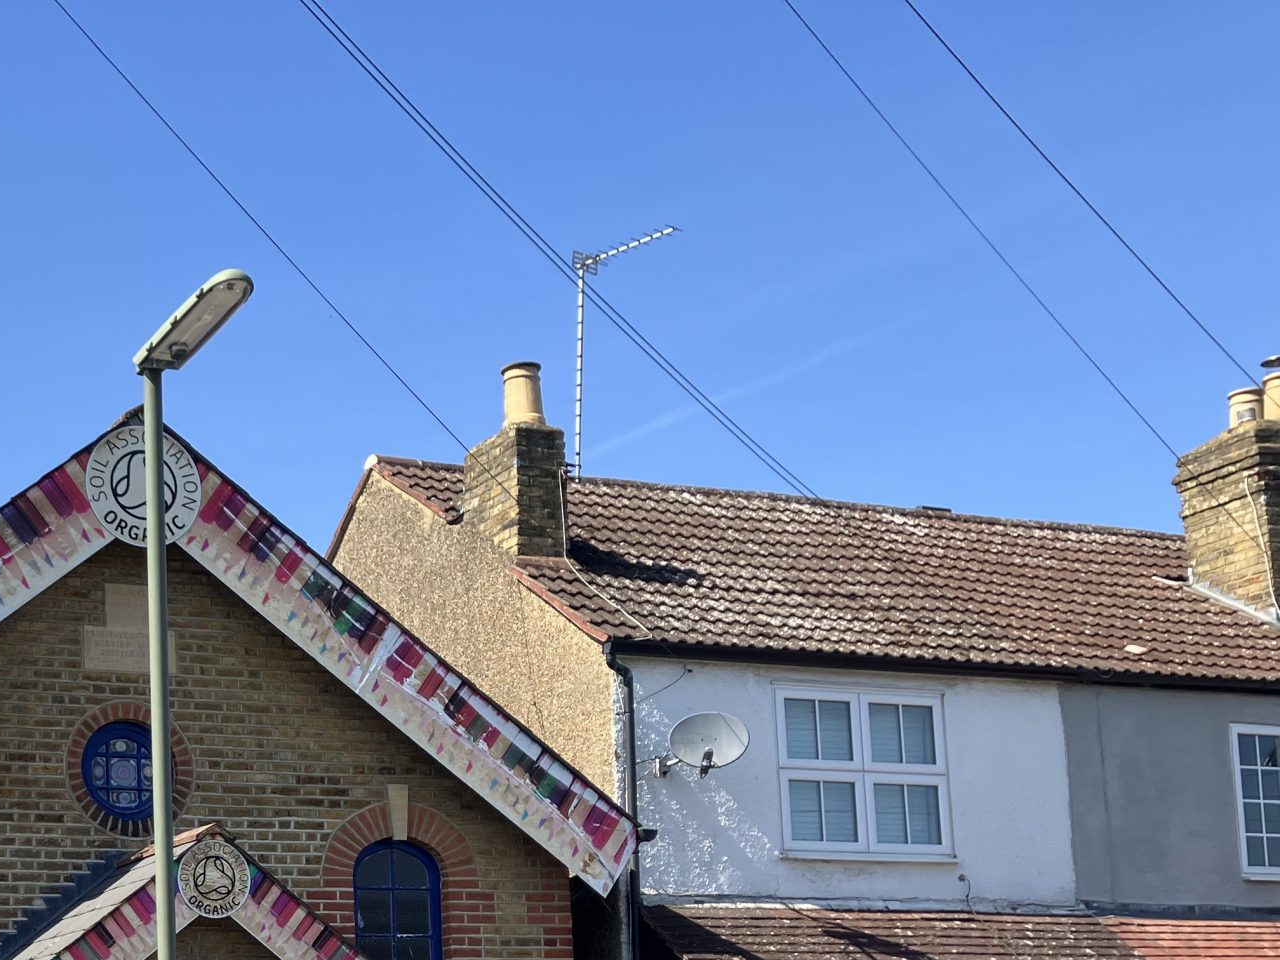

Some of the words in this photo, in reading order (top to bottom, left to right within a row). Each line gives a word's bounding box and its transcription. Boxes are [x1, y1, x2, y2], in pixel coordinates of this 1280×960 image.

[90, 460, 109, 502] SOIL
[106, 429, 198, 511] ASSIATION
[104, 510, 185, 542] ORGIC
[180, 862, 193, 890] SOIL
[192, 842, 249, 894] ASSOCIATION
[189, 895, 240, 915] ORGANIC
